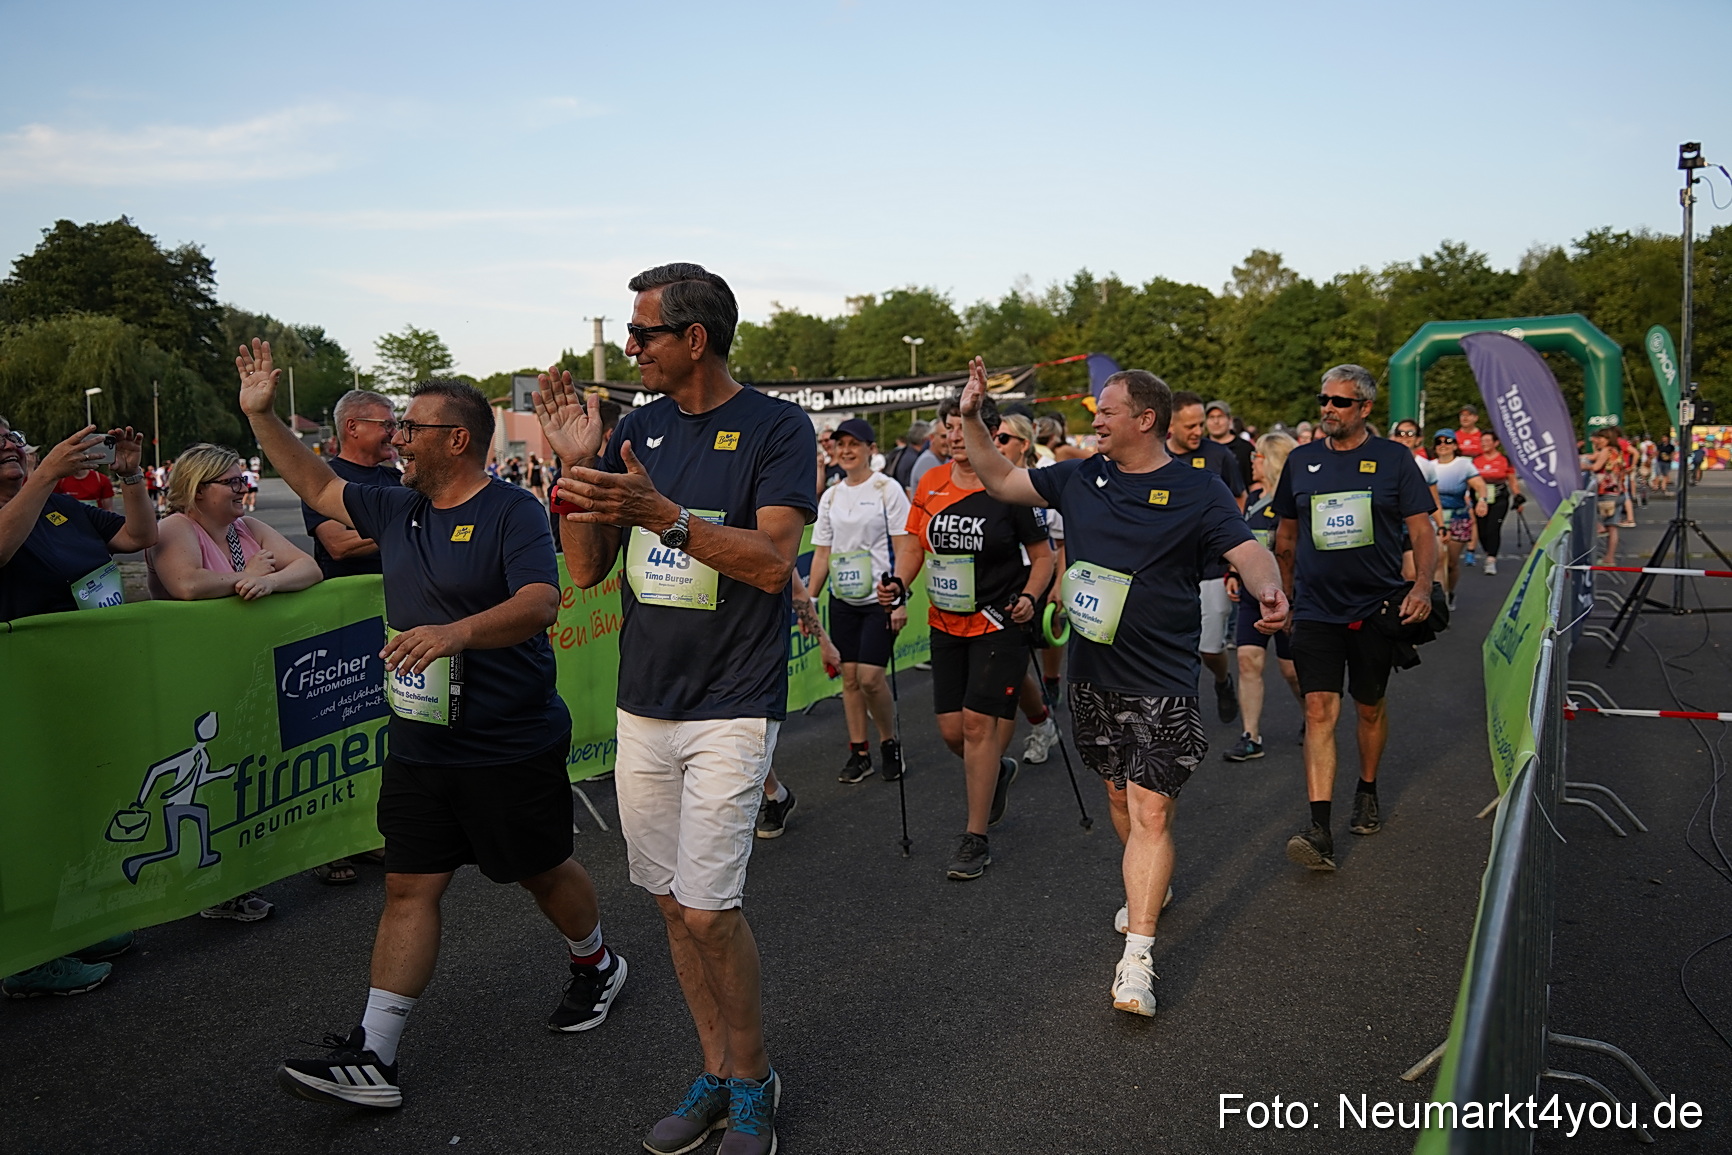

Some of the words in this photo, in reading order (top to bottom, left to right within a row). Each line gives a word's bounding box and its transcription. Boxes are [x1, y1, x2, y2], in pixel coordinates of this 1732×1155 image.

[632, 391, 666, 407] Au
[933, 514, 986, 536] HECK
[1326, 514, 1355, 528] 458
[932, 532, 984, 552] DESIGN
[647, 547, 691, 570] 443
[645, 571, 664, 581] Timo
[664, 573, 693, 585] Burger
[837, 570, 861, 582] 2731
[932, 576, 958, 591] 1138
[1074, 591, 1100, 612] 471
[298, 654, 370, 691] Fischer
[394, 667, 426, 690] 463
[306, 672, 366, 700] AUTOMOBILE
[405, 691, 439, 704] Schönfeld
[239, 779, 356, 848] neumarkt
